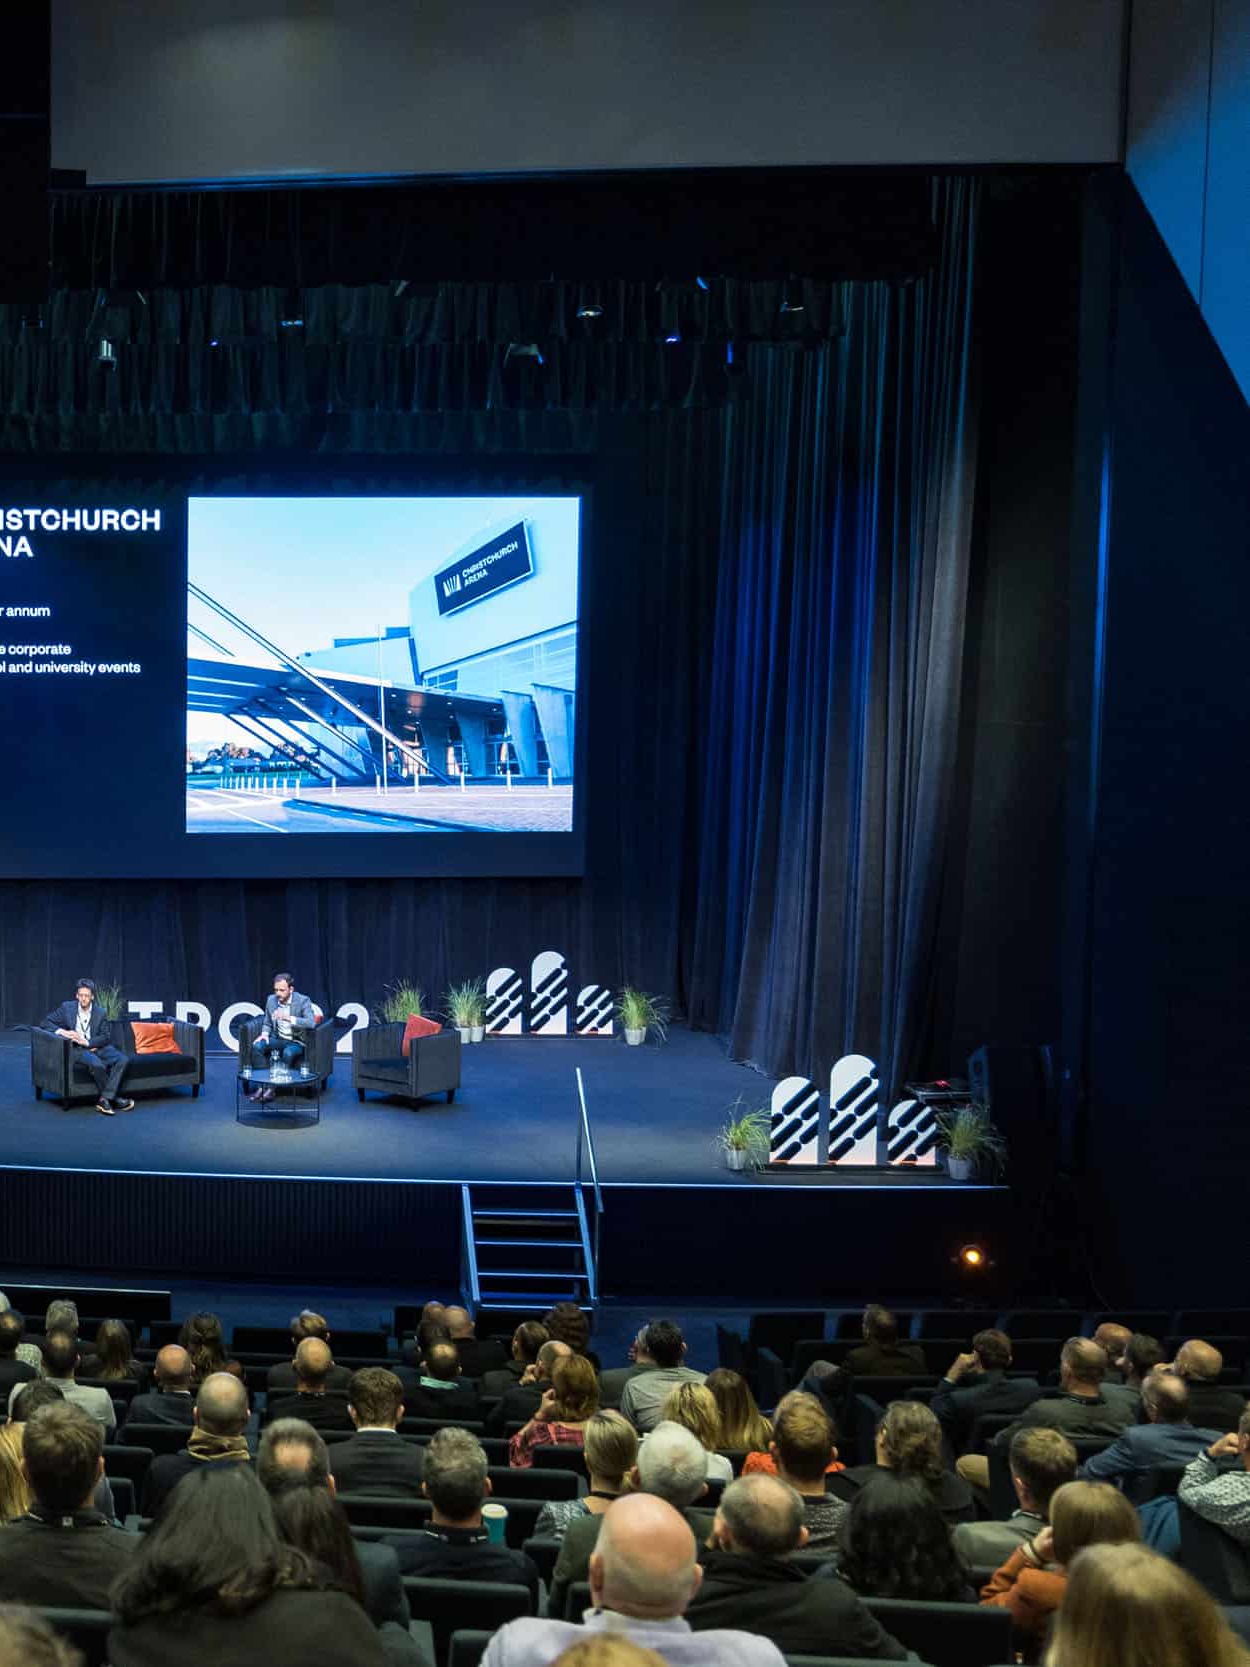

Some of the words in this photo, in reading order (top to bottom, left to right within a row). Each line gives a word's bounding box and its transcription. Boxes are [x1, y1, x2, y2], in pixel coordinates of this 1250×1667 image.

[462, 541, 518, 577] CHRISTCHURCH
[464, 569, 488, 586] ARENA
[6, 607, 51, 617] annum
[8, 644, 72, 657] corporate
[8, 661, 33, 673] and
[35, 661, 96, 676] university
[98, 662, 141, 673] events
